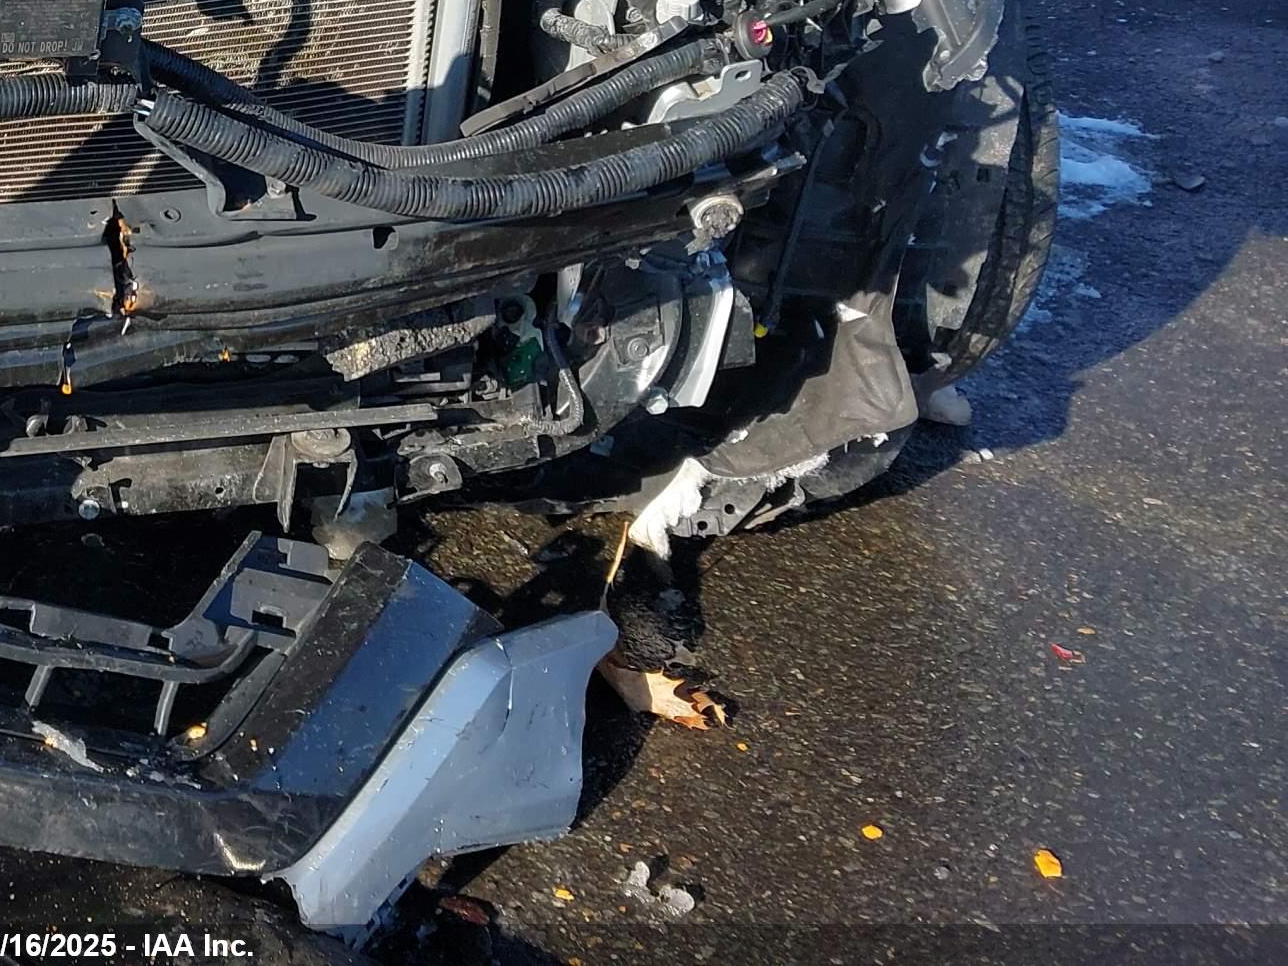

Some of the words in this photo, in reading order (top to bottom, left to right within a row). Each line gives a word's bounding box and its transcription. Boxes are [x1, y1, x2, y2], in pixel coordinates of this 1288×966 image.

[2, 41, 14, 54] DO
[18, 41, 36, 53] NOT
[40, 40, 68, 53] DROP!
